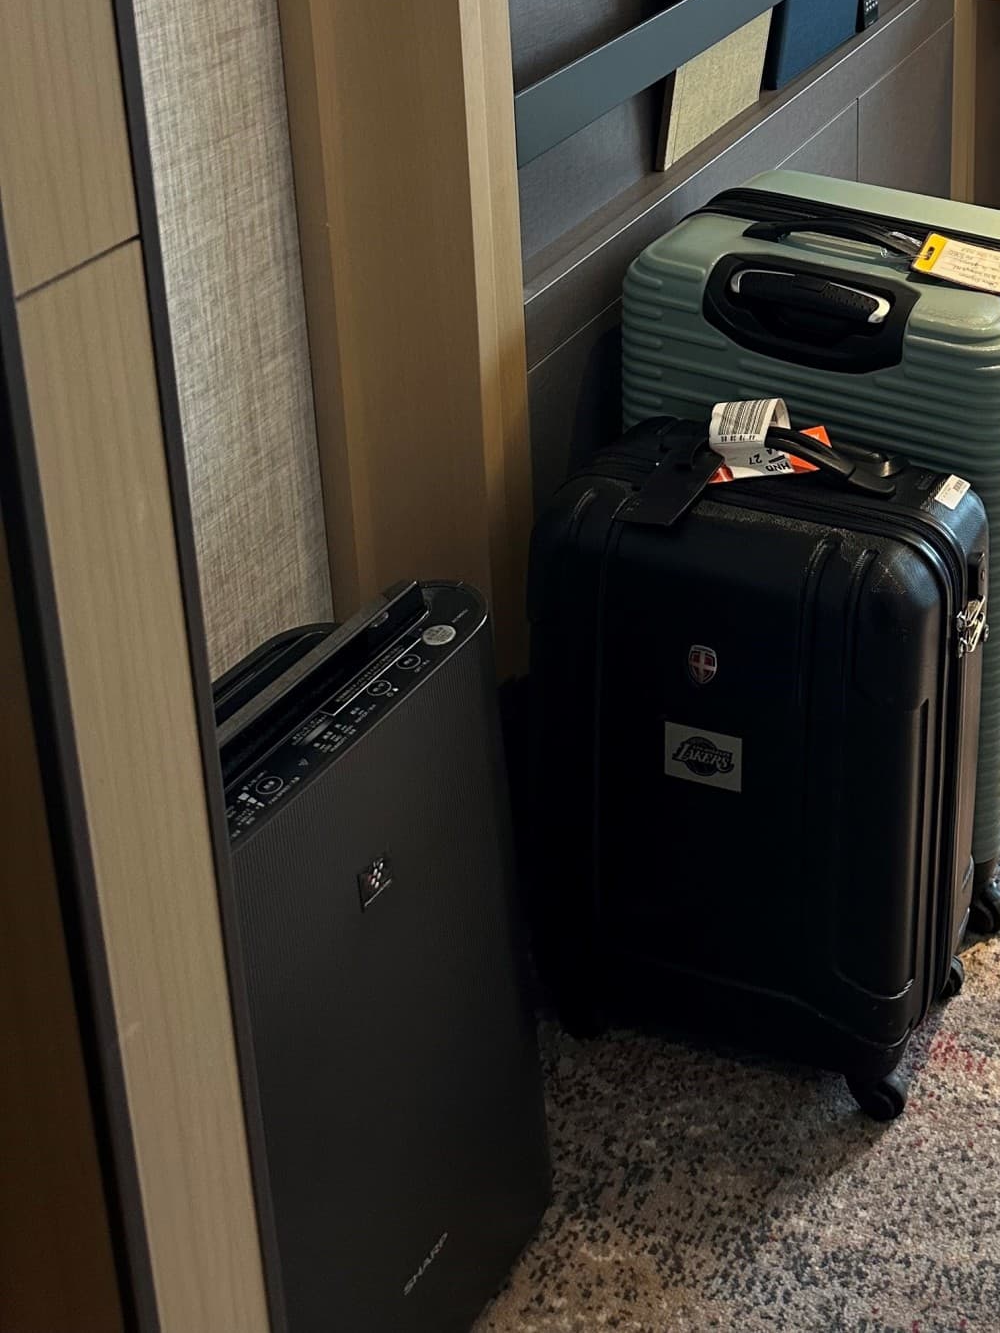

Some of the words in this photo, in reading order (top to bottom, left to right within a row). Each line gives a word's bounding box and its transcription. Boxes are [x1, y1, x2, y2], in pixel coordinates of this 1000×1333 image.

[749, 453, 763, 465] 27
[765, 461, 791, 472] HND
[674, 742, 734, 773] LAKERS
